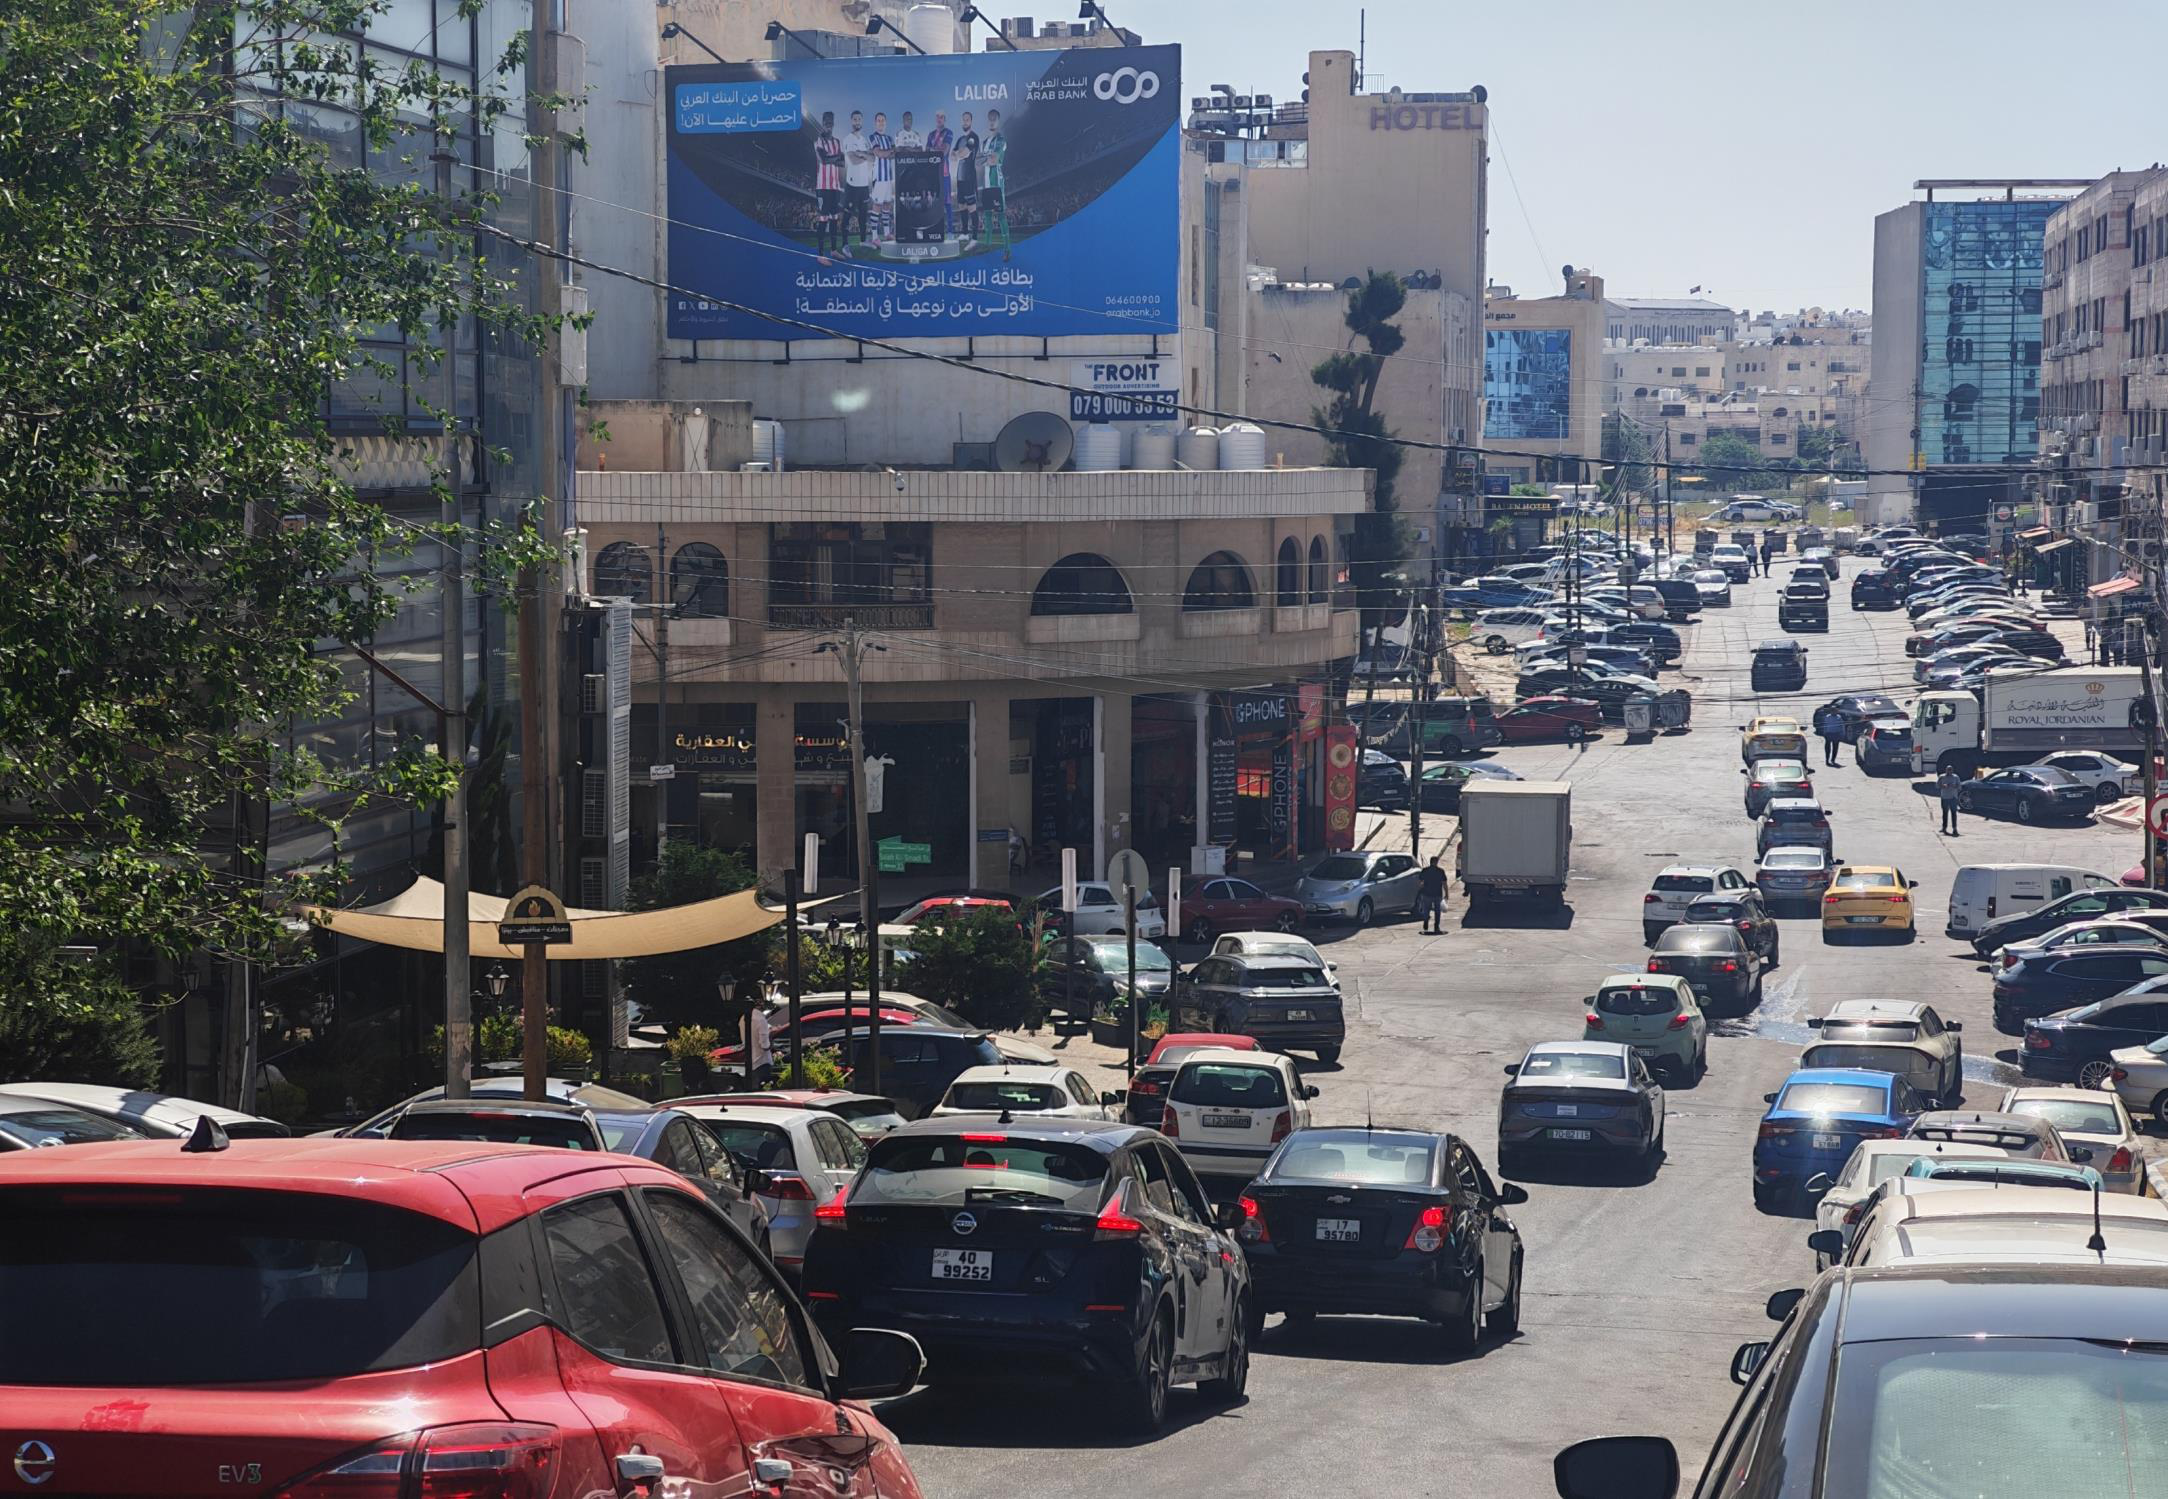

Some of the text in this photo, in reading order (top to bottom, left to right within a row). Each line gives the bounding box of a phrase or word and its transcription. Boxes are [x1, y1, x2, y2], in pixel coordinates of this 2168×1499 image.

[1025, 76, 1088, 90] البنك العربي
[712, 90, 738, 105] البنك
[742, 94, 759, 106] من
[954, 83, 1008, 101] LALIGA
[1026, 90, 1087, 101] ARAB BANK
[680, 91, 709, 110] العربي
[1370, 105, 1484, 131] HOTEL
[901, 247, 928, 256] LALIGA
[795, 271, 857, 289] الائتمانية
[949, 270, 986, 290] البنك
[991, 267, 1033, 289] بطاقة
[1105, 295, 1160, 305] 064600900
[878, 295, 892, 322] في
[950, 301, 973, 317] من
[1106, 307, 1160, 318] arabbank.jo
[1093, 363, 1160, 381] FRONT
[1074, 395, 1101, 415] 079
[1104, 395, 1132, 415] 000
[1236, 698, 1285, 723] GPHONE
[2008, 715, 2105, 726] ROYAL JORDANIAN
[675, 732, 735, 750] العقارية
[1336, 1220, 1348, 1230] 17
[1324, 1230, 1359, 1241] 95780
[958, 1251, 977, 1265] 40
[943, 1264, 990, 1279] 99252
[218, 1463, 262, 1485] EV3
